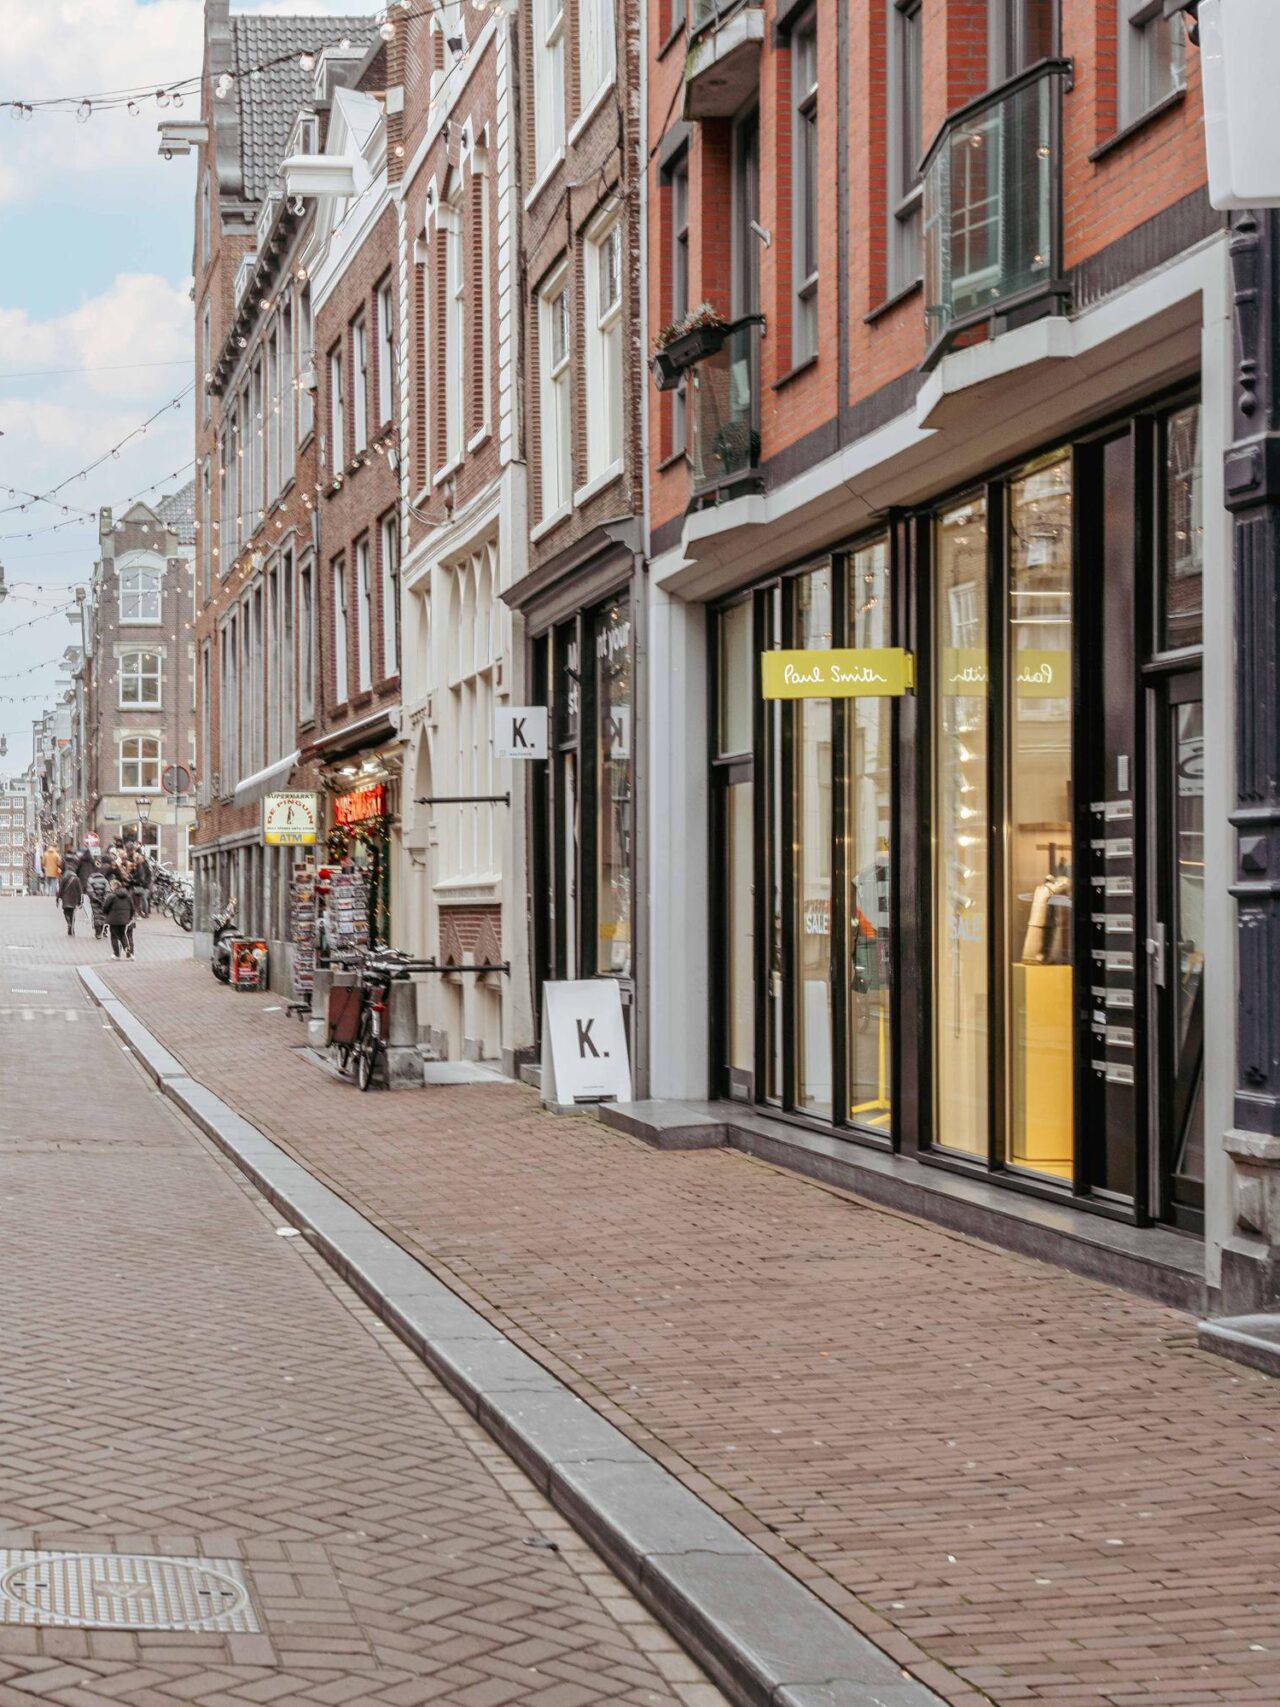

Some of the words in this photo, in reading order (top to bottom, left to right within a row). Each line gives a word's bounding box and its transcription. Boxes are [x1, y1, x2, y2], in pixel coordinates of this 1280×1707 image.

[783, 663, 825, 685] Paul
[831, 665, 888, 683] Smith
[512, 717, 536, 748] K.
[277, 799, 314, 825] PINGUIN
[280, 833, 303, 842] ATM
[806, 913, 829, 934] SALE
[576, 1018, 610, 1058] K.
